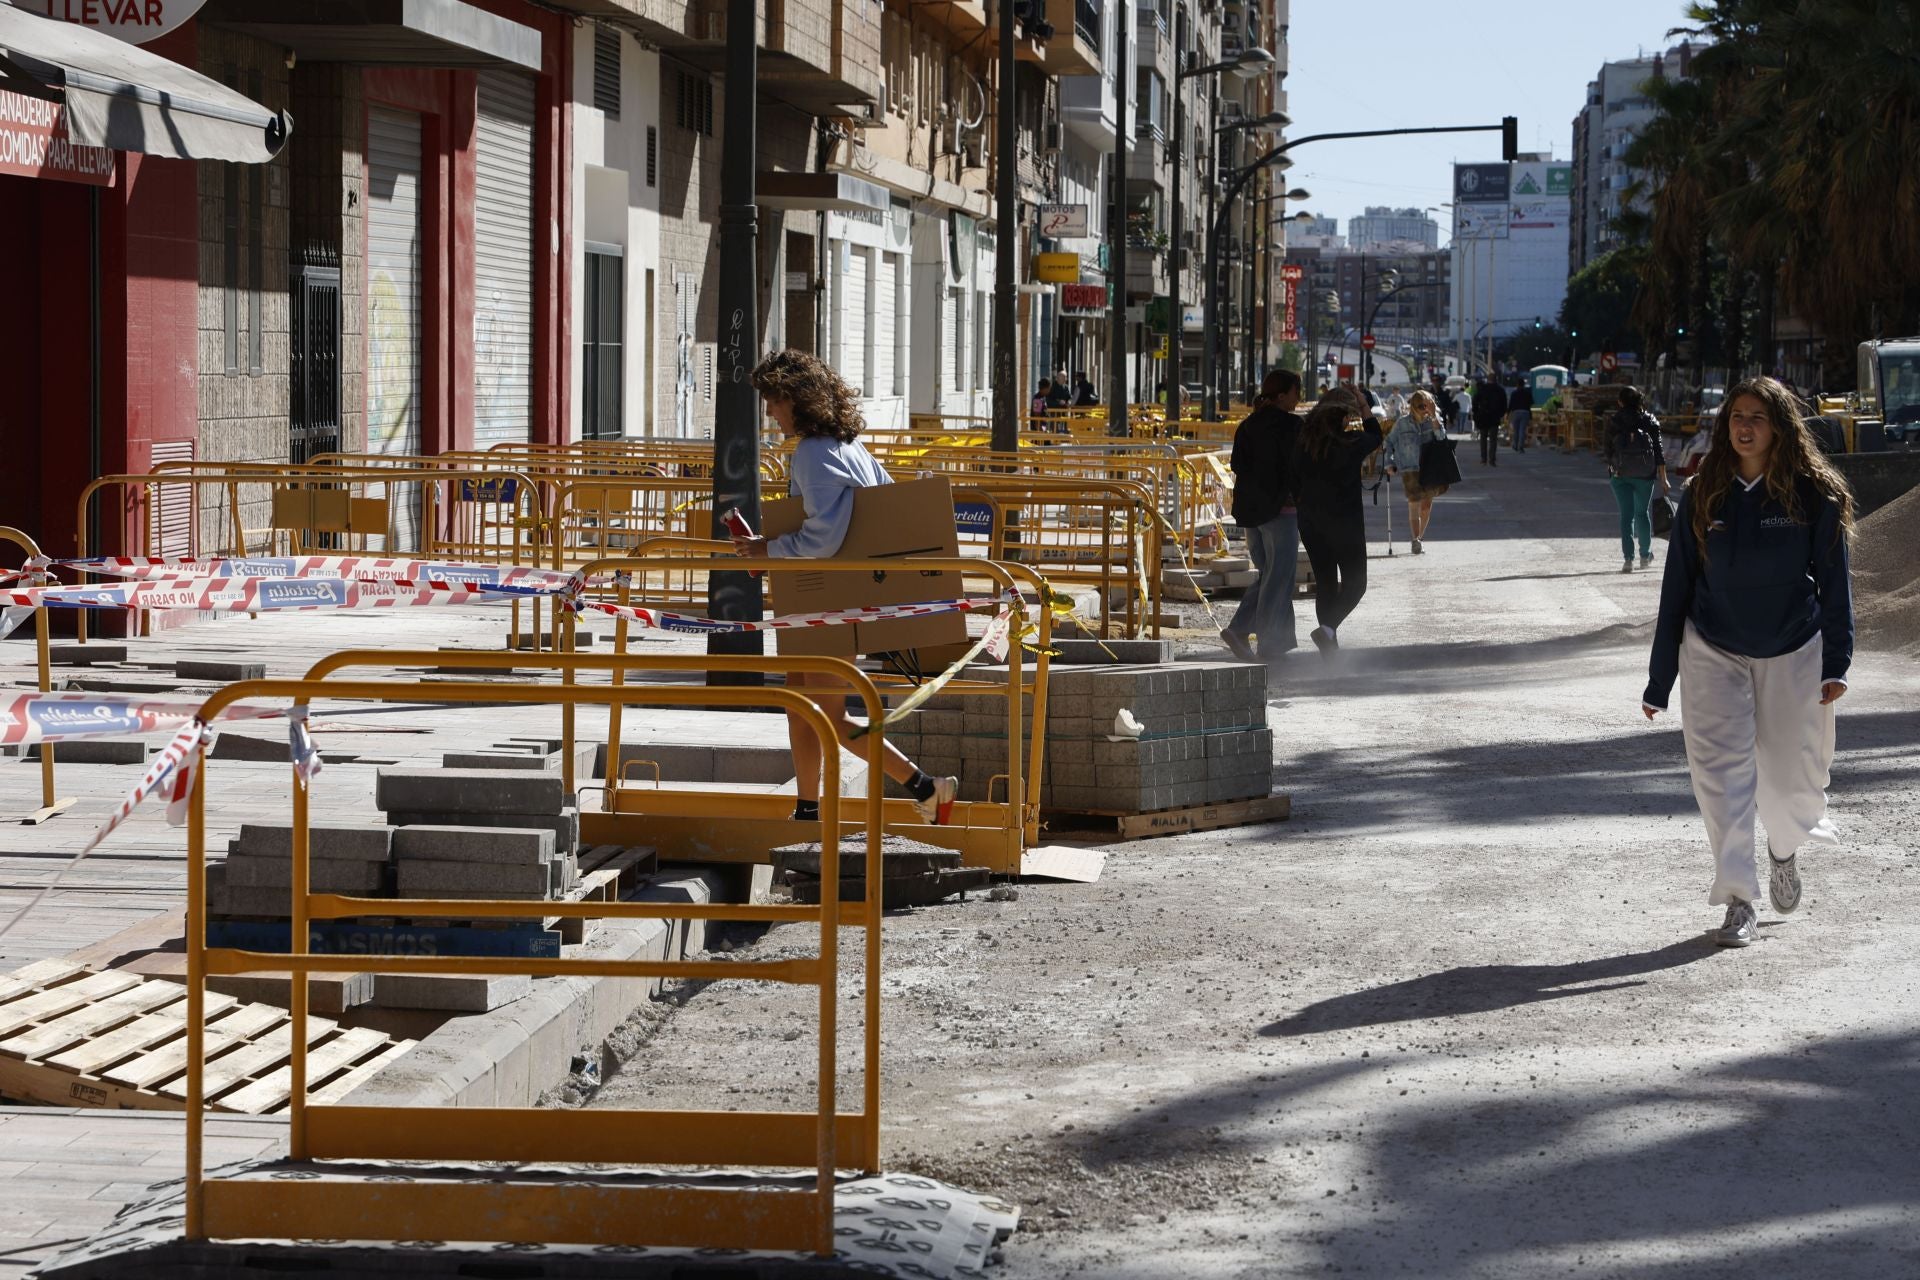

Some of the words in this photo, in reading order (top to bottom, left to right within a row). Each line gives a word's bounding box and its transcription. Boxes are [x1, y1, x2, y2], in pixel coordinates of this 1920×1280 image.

[48, 136, 75, 171] PARA
[1042, 206, 1076, 214] MOTOS
[1287, 282, 1295, 331] LAVADO
